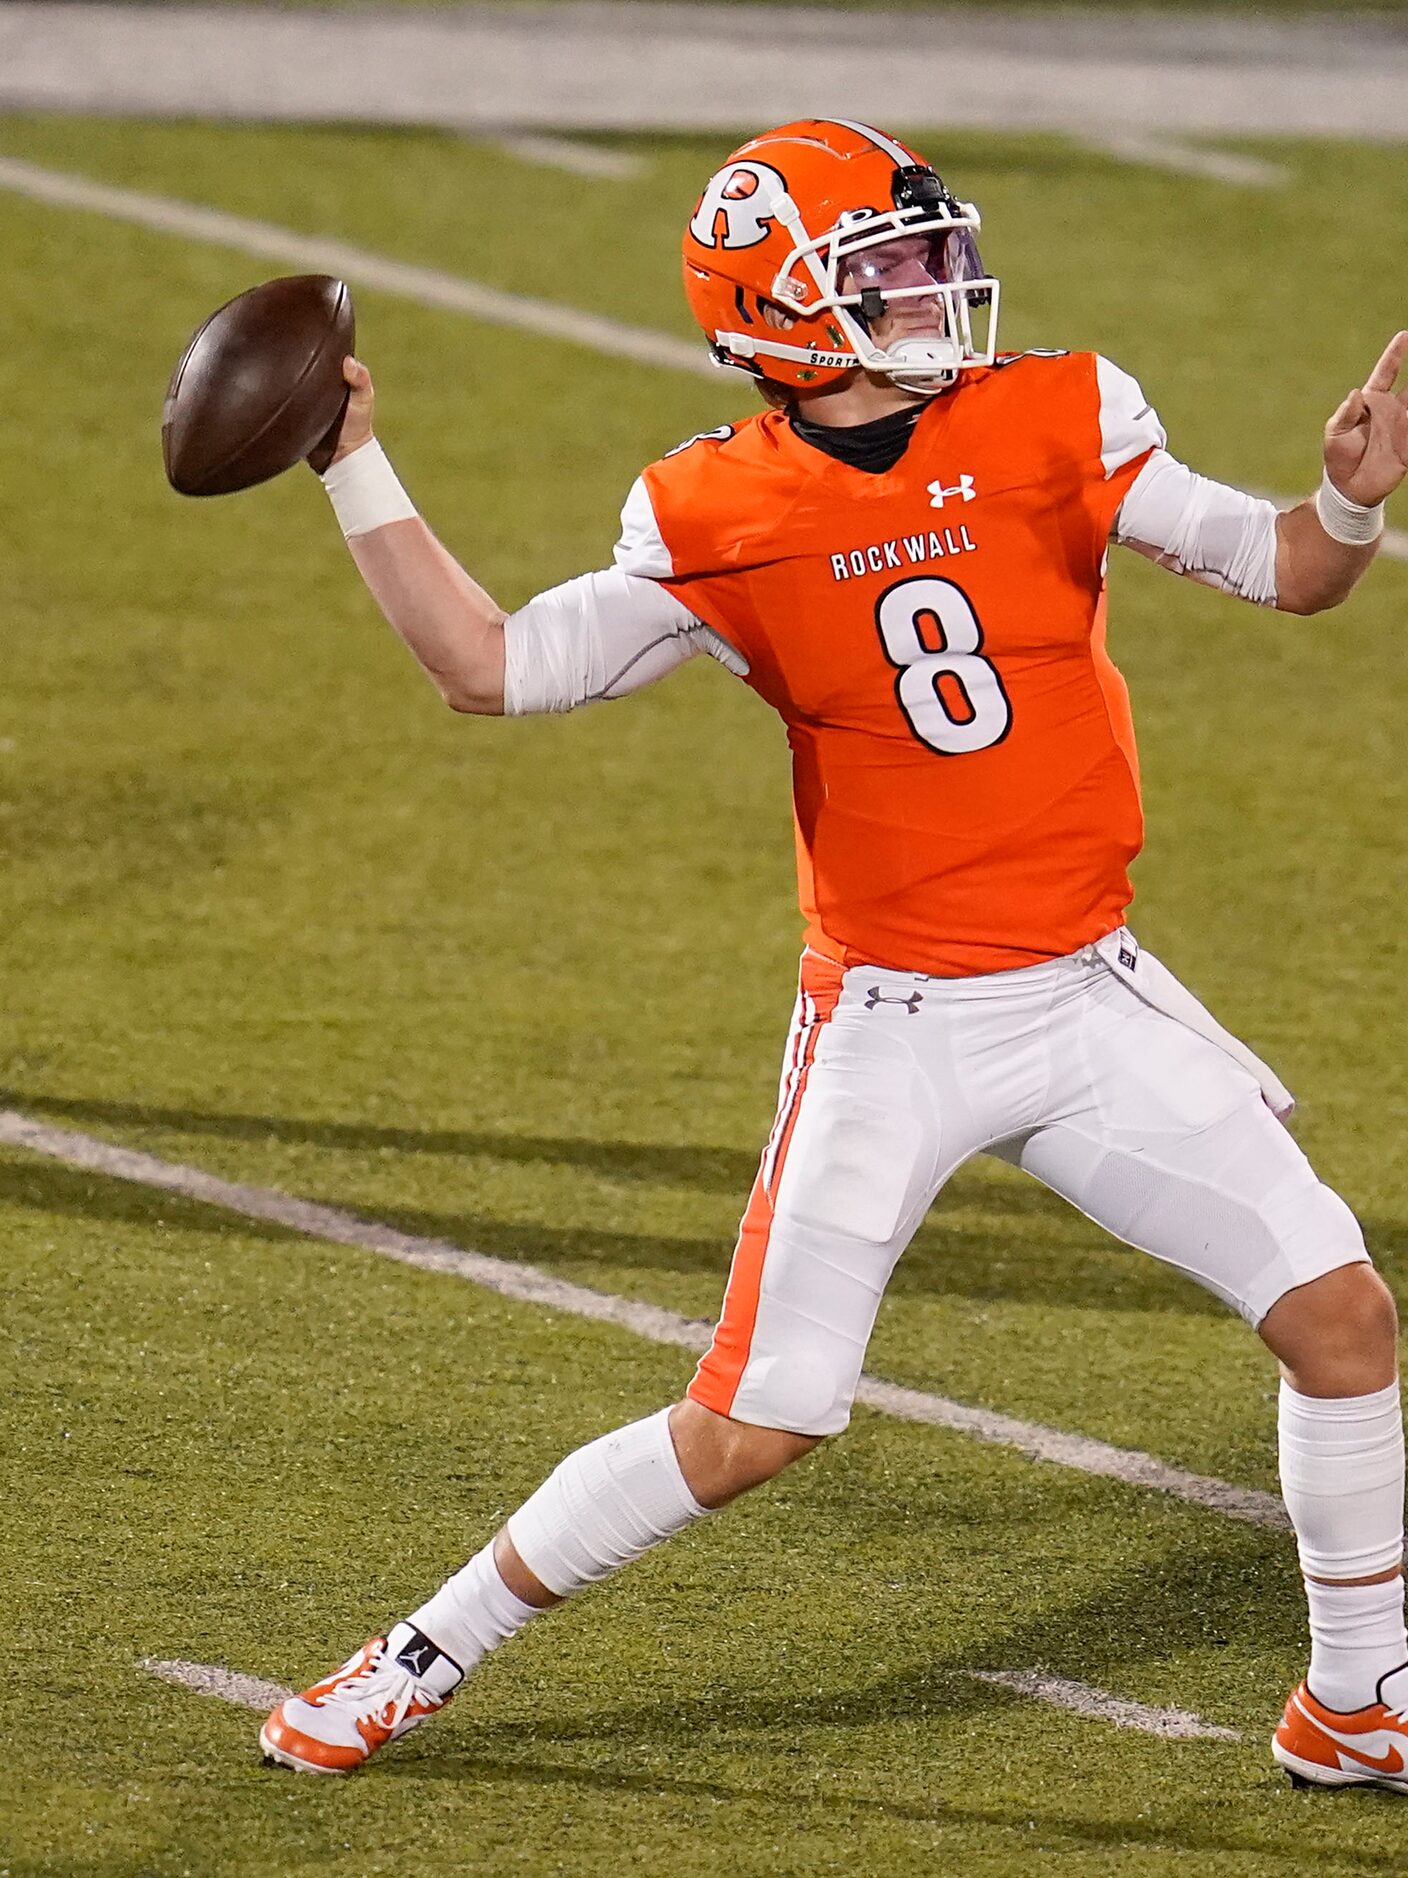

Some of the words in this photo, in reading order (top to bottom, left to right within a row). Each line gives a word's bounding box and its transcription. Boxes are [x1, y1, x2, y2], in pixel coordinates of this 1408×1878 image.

[690, 160, 788, 250] R
[830, 524, 977, 581] ROCKWALL
[874, 575, 1013, 757] 8
